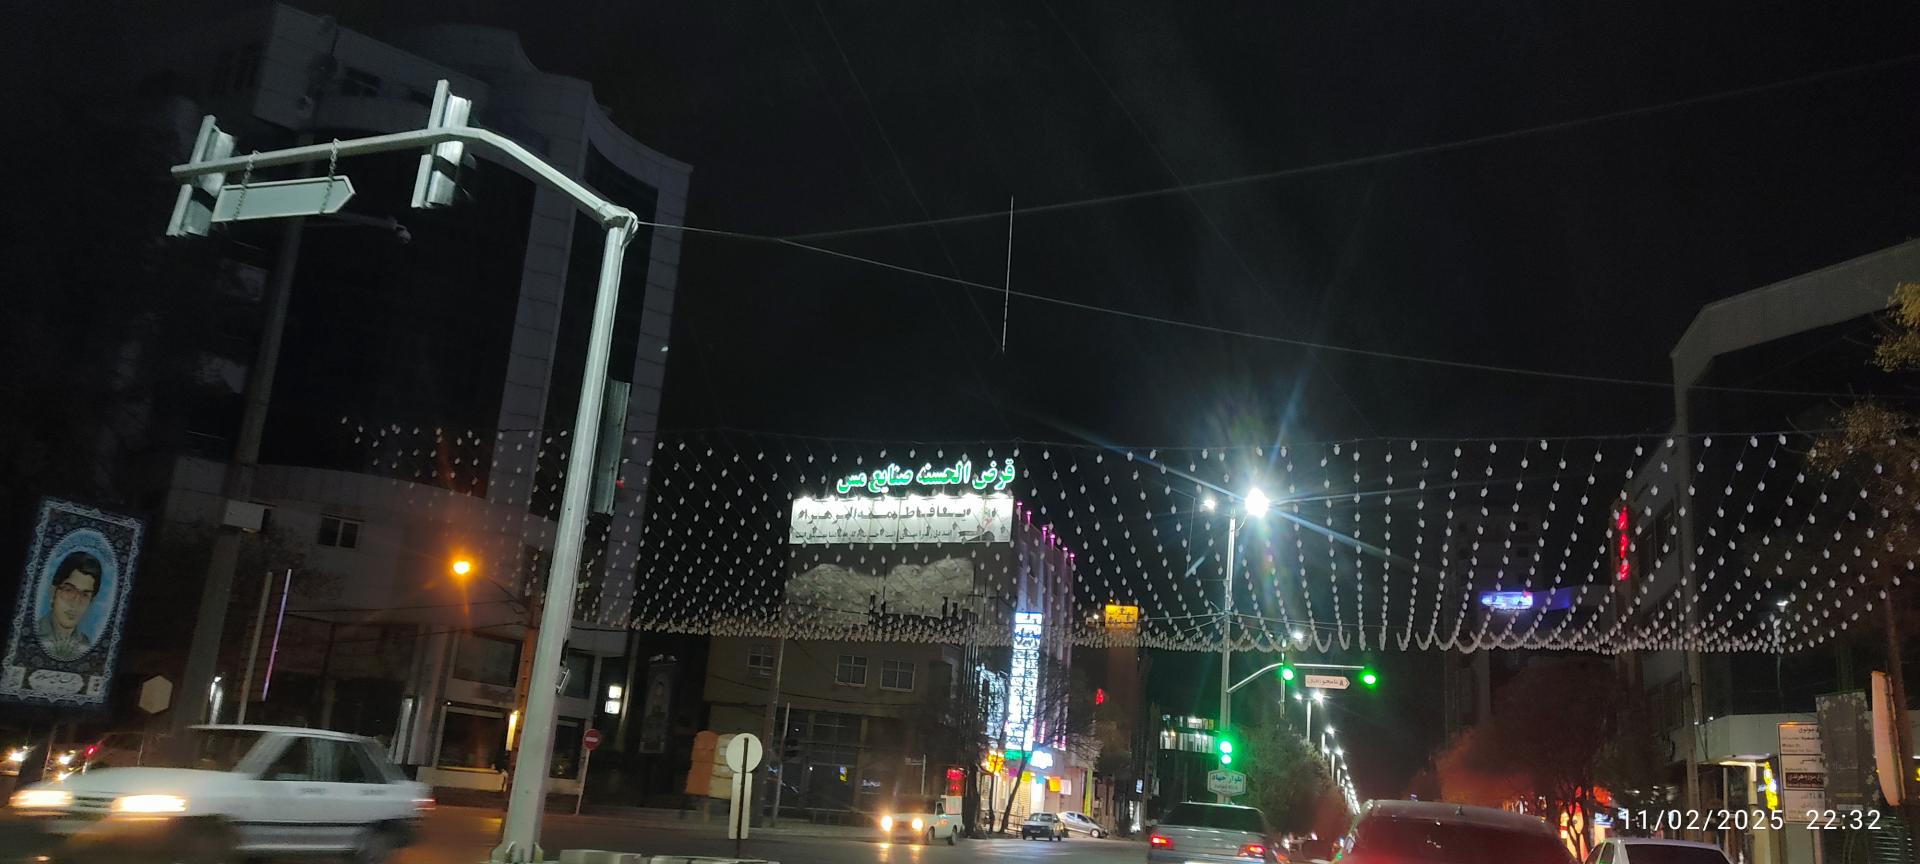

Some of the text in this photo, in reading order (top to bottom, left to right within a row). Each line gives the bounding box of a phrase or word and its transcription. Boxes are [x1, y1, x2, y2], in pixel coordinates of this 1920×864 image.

[837, 458, 1015, 493] قرض الحسنه صنایع مس
